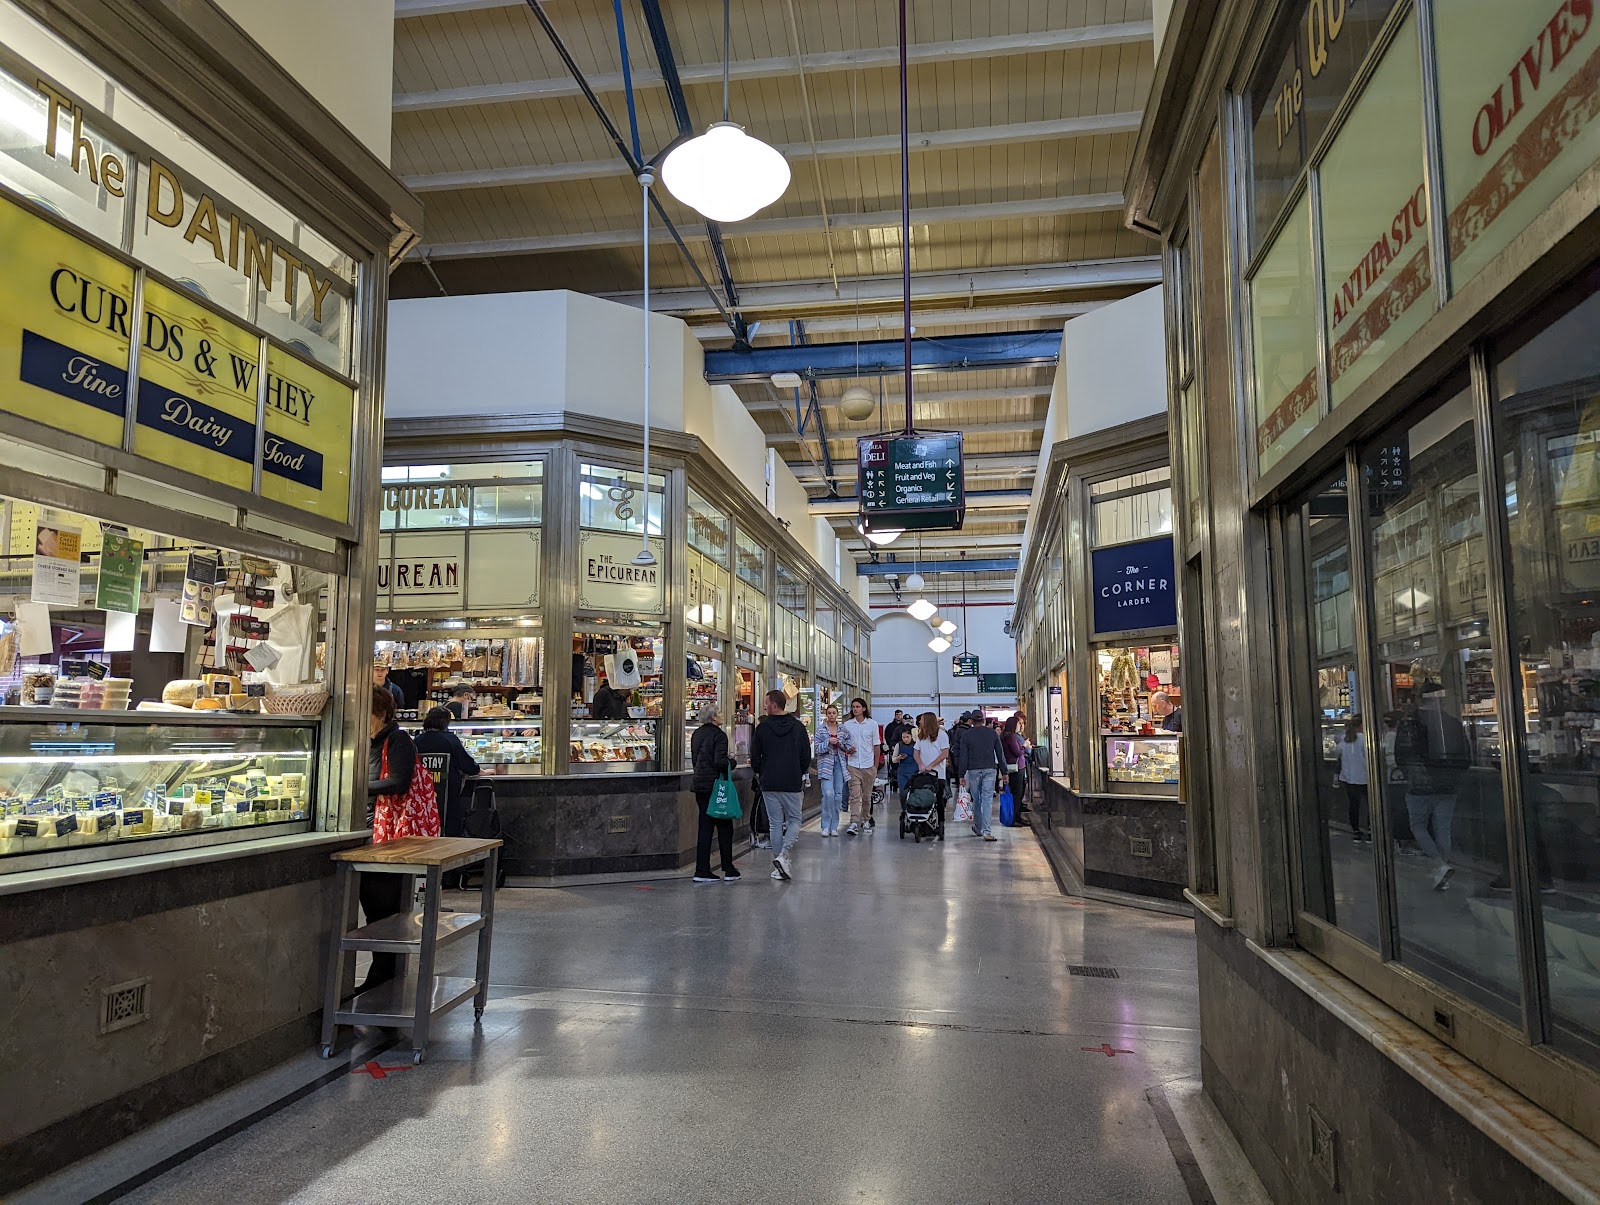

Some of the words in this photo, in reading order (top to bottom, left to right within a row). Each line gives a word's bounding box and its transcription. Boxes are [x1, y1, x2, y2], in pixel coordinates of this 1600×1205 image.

[1472, 0, 1593, 156] OLIVES
[1274, 68, 1302, 149] The
[36, 78, 125, 197] The
[147, 157, 332, 324] DAINTY
[1332, 183, 1428, 329] ANTIPASTO
[50, 268, 184, 362] CURDS
[194, 338, 218, 379] &
[228, 353, 315, 423] WHEY
[62, 356, 122, 399] Fine
[160, 397, 234, 447] Dairy
[262, 437, 305, 471] Food
[864, 452, 886, 462] DELI
[895, 473, 909, 481] Fruit
[923, 472, 936, 482] Veg
[896, 484, 923, 494] Organics
[896, 495, 920, 504] General
[921, 494, 939, 502] Retail
[600, 554, 613, 564] THE
[588, 558, 656, 584] EPICUREAN
[1126, 566, 1140, 574] The
[1101, 578, 1168, 598] CORNER
[1118, 597, 1150, 608] LARDER
[422, 756, 444, 768] STAY
